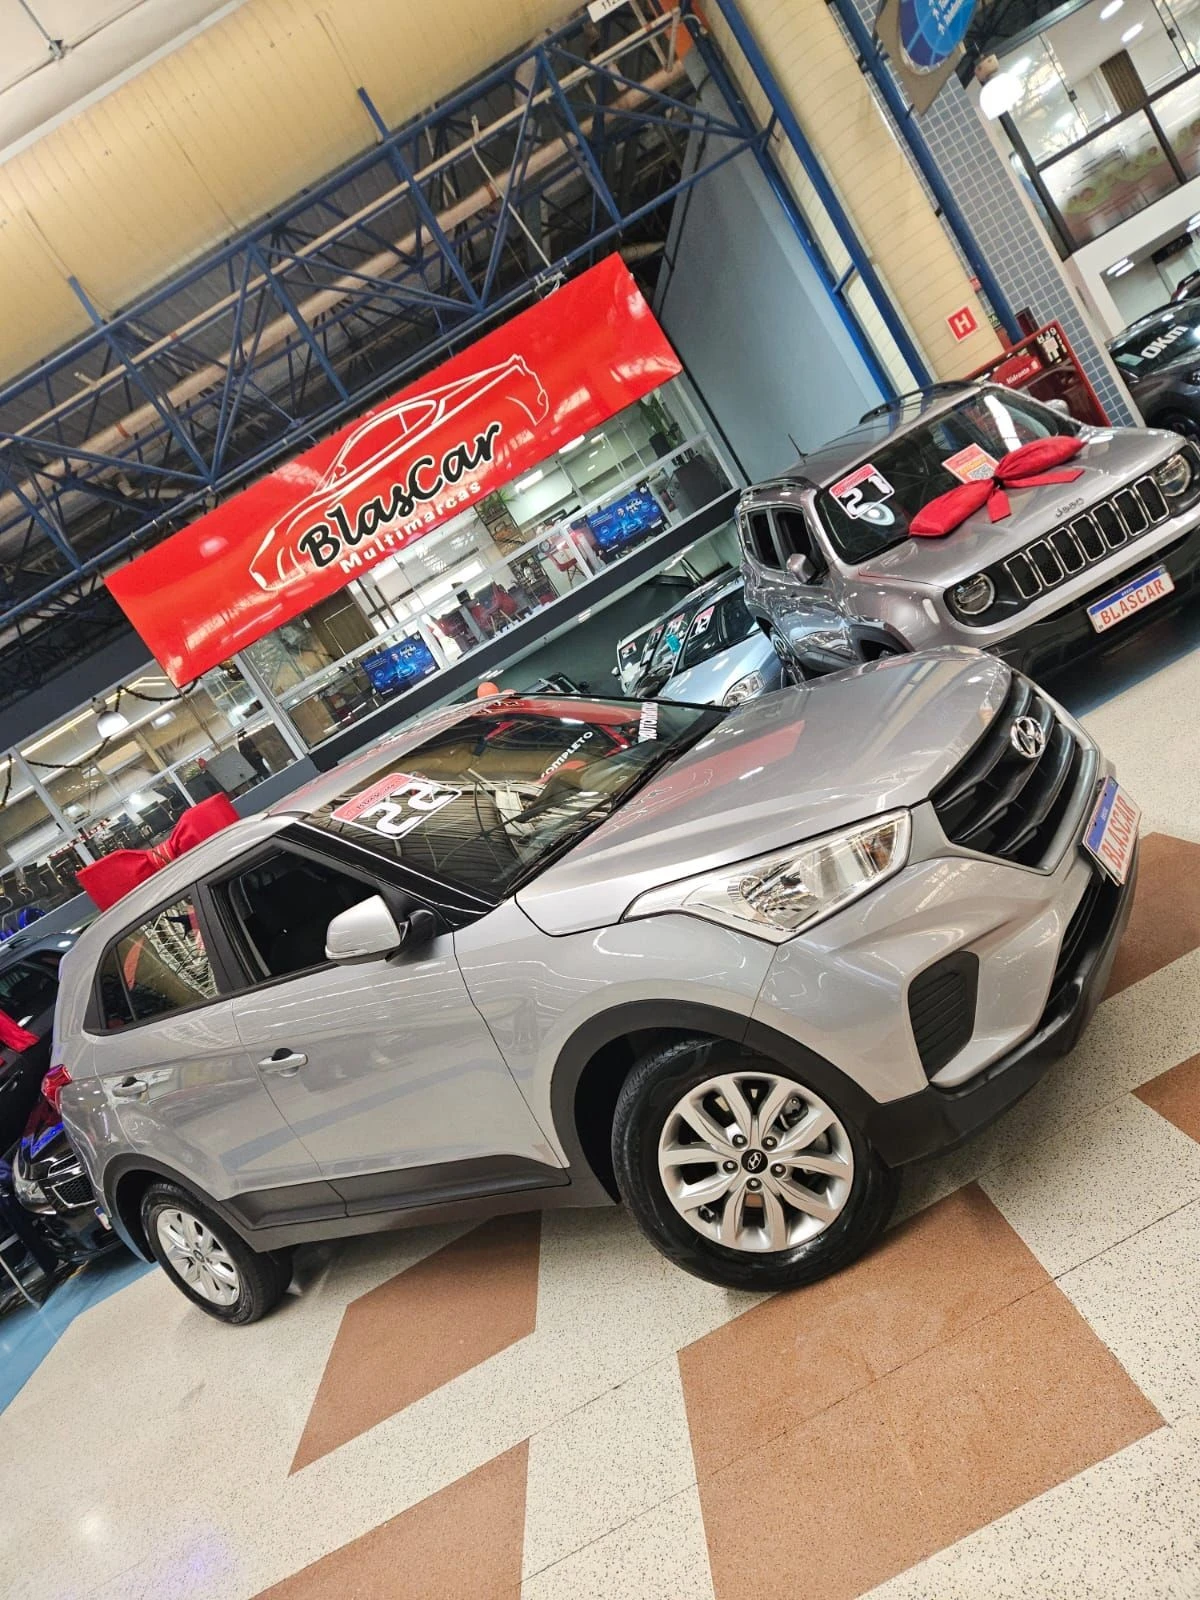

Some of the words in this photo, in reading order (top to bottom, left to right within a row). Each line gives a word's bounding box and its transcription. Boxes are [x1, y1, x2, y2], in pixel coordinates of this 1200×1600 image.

[954, 313, 972, 334] H
[299, 421, 501, 568] BlasCar
[840, 475, 892, 516] 21
[338, 480, 481, 574] Multimarcas
[1100, 578, 1165, 625] BLASCAR
[360, 782, 455, 834] 22
[1101, 794, 1136, 871] BLASCAR
